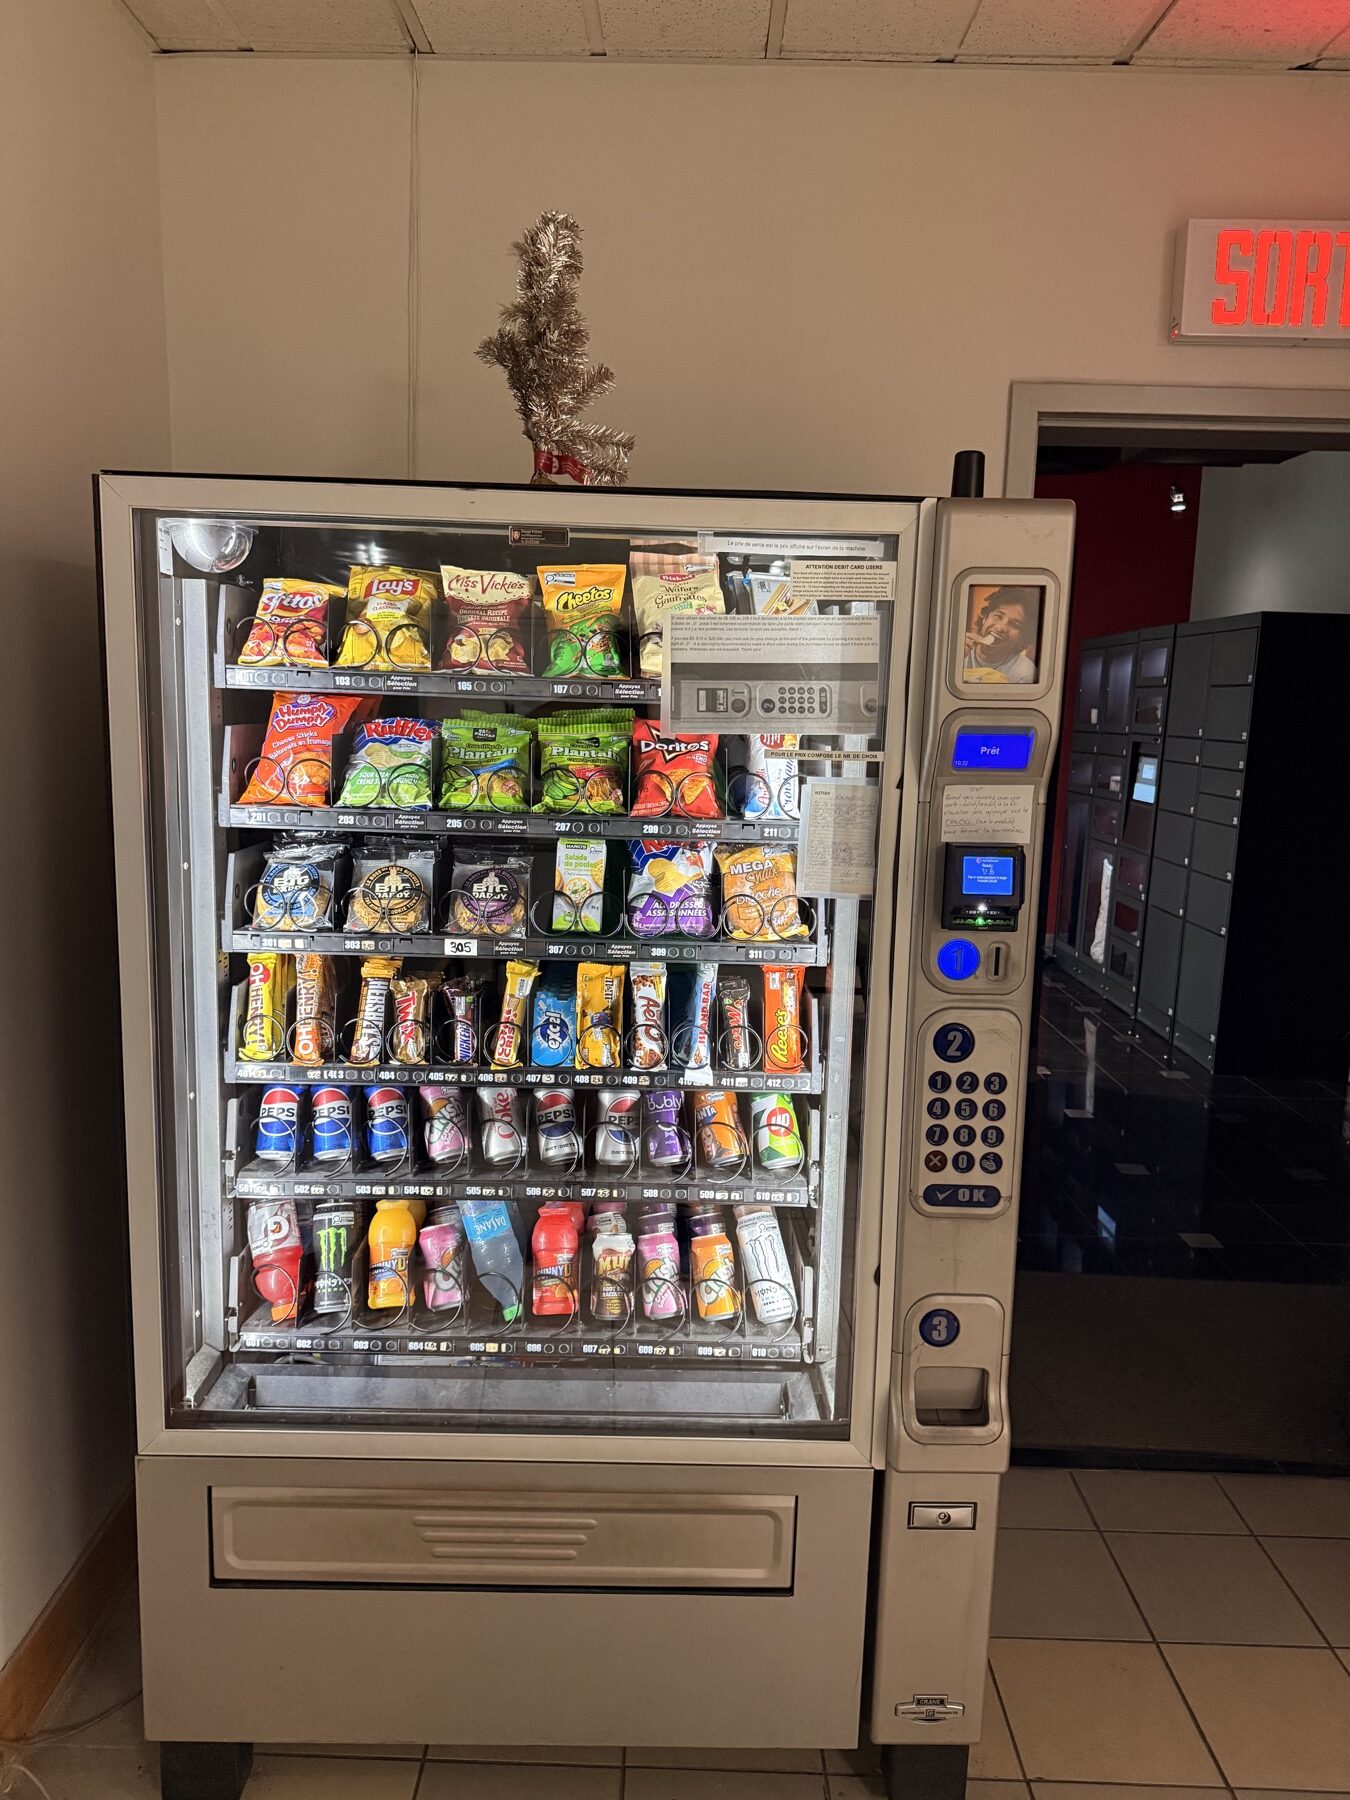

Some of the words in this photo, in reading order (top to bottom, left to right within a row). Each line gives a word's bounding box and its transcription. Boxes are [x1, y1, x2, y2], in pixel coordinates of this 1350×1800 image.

[372, 578, 415, 595] Lay's
[481, 574, 526, 595] Vickie's
[556, 585, 614, 611] Cheetos
[335, 676, 350, 686] 103
[457, 682, 472, 691] 105
[553, 685, 568, 694] 107
[640, 740, 709, 753] Doritos
[980, 746, 1000, 755] Prêt
[448, 746, 518, 760] Plantain
[552, 747, 622, 762] Plantain
[338, 816, 354, 825] 203
[447, 819, 462, 828] 205
[556, 822, 570, 831] 207
[643, 825, 659, 834] 209
[764, 828, 777, 837] 211
[729, 859, 773, 875] MEGA
[345, 941, 360, 949] 303
[449, 942, 472, 953] 305
[549, 946, 564, 954] 307
[651, 948, 666, 956] 309
[749, 950, 762, 959] 311
[952, 946, 963, 974] 1
[395, 991, 416, 1044] TWIX
[770, 1008, 787, 1063] Reese's
[947, 1031, 963, 1057] 2
[379, 1072, 395, 1080] 404
[429, 1072, 444, 1081] 405
[478, 1073, 494, 1082] 406
[526, 1074, 540, 1083] 407
[574, 1075, 589, 1083] 408
[623, 1076, 638, 1084] 409
[720, 1077, 734, 1086] 411
[767, 1079, 781, 1087] 412
[935, 1075, 942, 1089] 1
[962, 1075, 972, 1090] 2
[990, 1076, 999, 1090] 3
[933, 1101, 942, 1115] 4
[960, 1102, 970, 1116] 5
[988, 1103, 998, 1117] 6
[495, 1092, 515, 1139] Coke
[537, 1109, 575, 1122] PEPSI
[933, 1127, 941, 1141] 7
[959, 1128, 969, 1142] 8
[987, 1129, 997, 1143] 9
[958, 1154, 967, 1168] 0
[356, 1186, 371, 1194] 503
[404, 1186, 419, 1194] 504
[466, 1187, 481, 1195] 505
[526, 1188, 541, 1196] 506
[581, 1188, 596, 1196] 507
[643, 1189, 658, 1197] 508
[700, 1190, 714, 1199] 509
[756, 1192, 770, 1200] 510
[957, 1188, 985, 1202] OK
[932, 1316, 948, 1341] 3
[353, 1341, 369, 1349] 603
[470, 1343, 485, 1351] 605
[583, 1344, 598, 1353] 607
[698, 1346, 712, 1355] 609
[752, 1348, 766, 1357] 610
